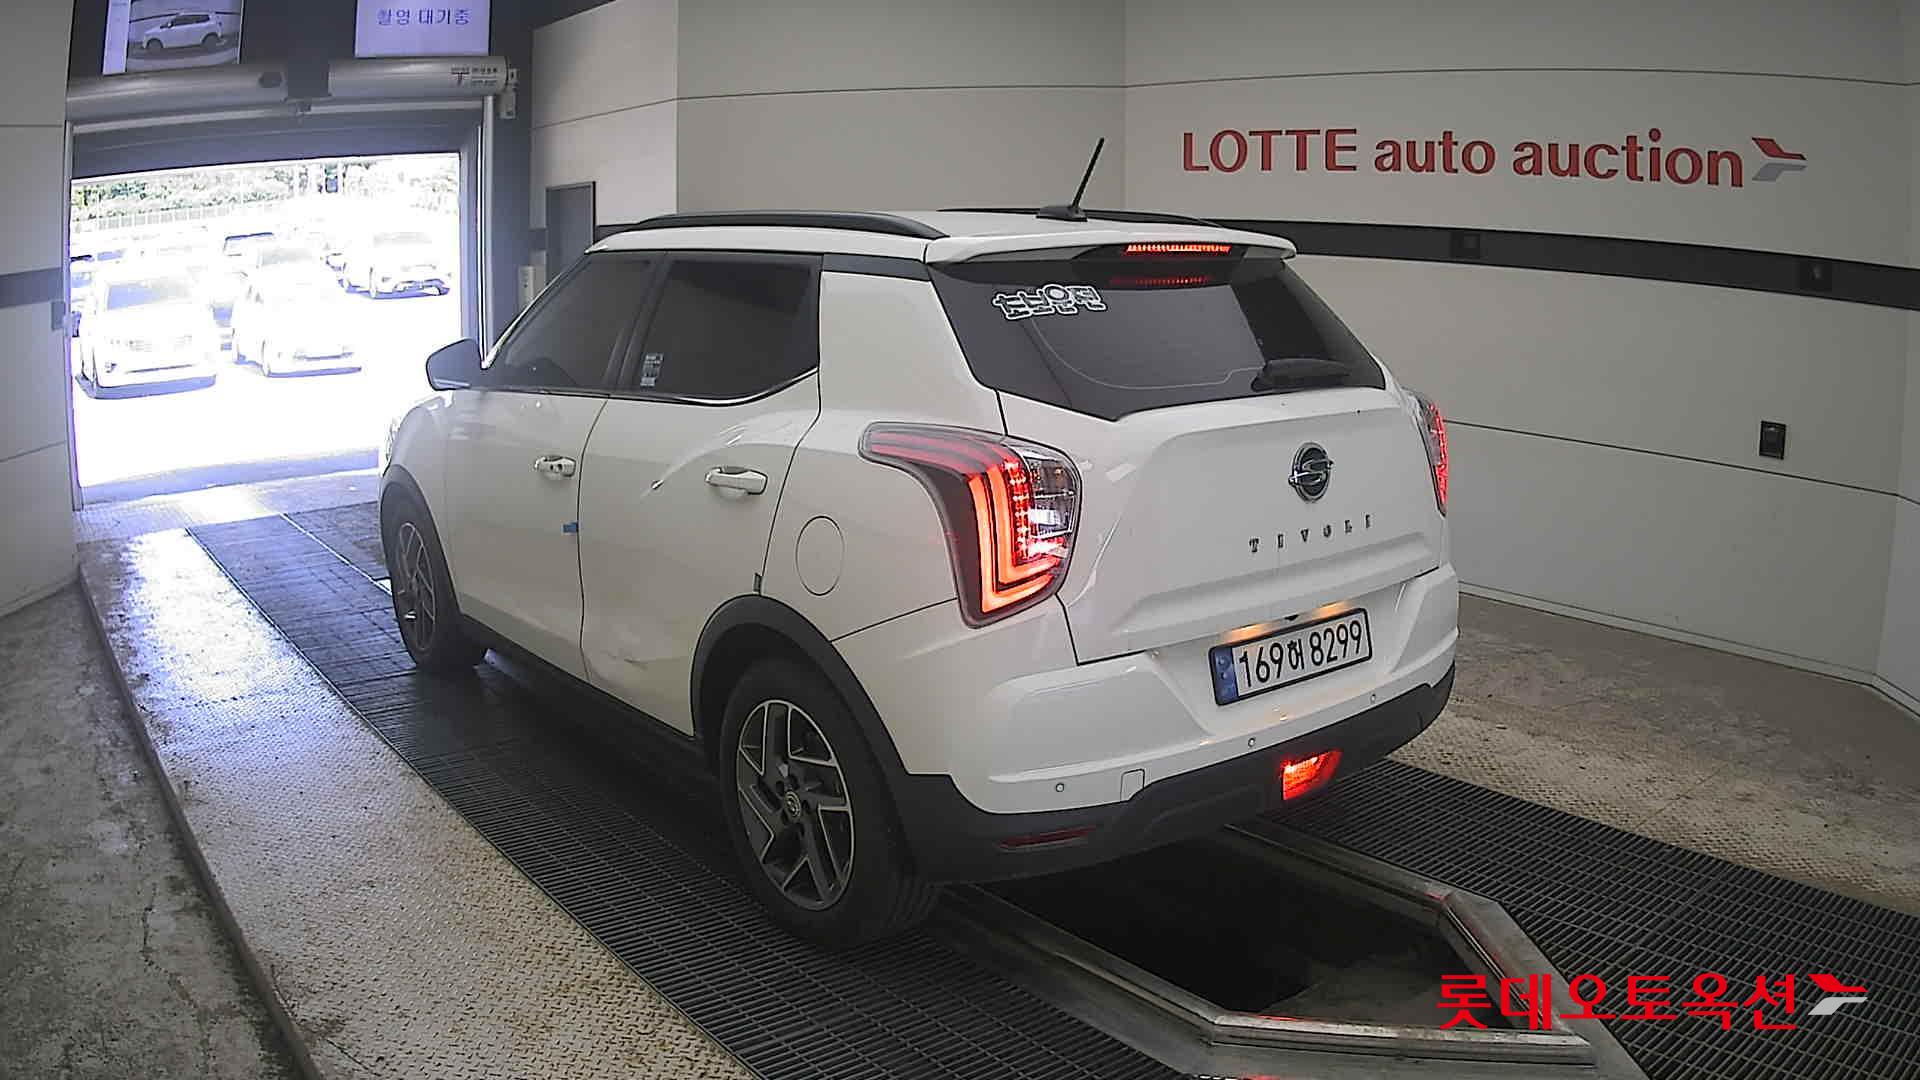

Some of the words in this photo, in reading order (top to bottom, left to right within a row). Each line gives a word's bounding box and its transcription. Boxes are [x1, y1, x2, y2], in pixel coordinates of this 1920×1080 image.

[418, 8, 471, 26] 대기중
[1183, 128, 1358, 173] LOTTE
[1374, 130, 1497, 175] auto
[1512, 127, 1744, 188] auction
[1248, 513, 1371, 553] TIVOLI
[1308, 619, 1362, 667] 8299
